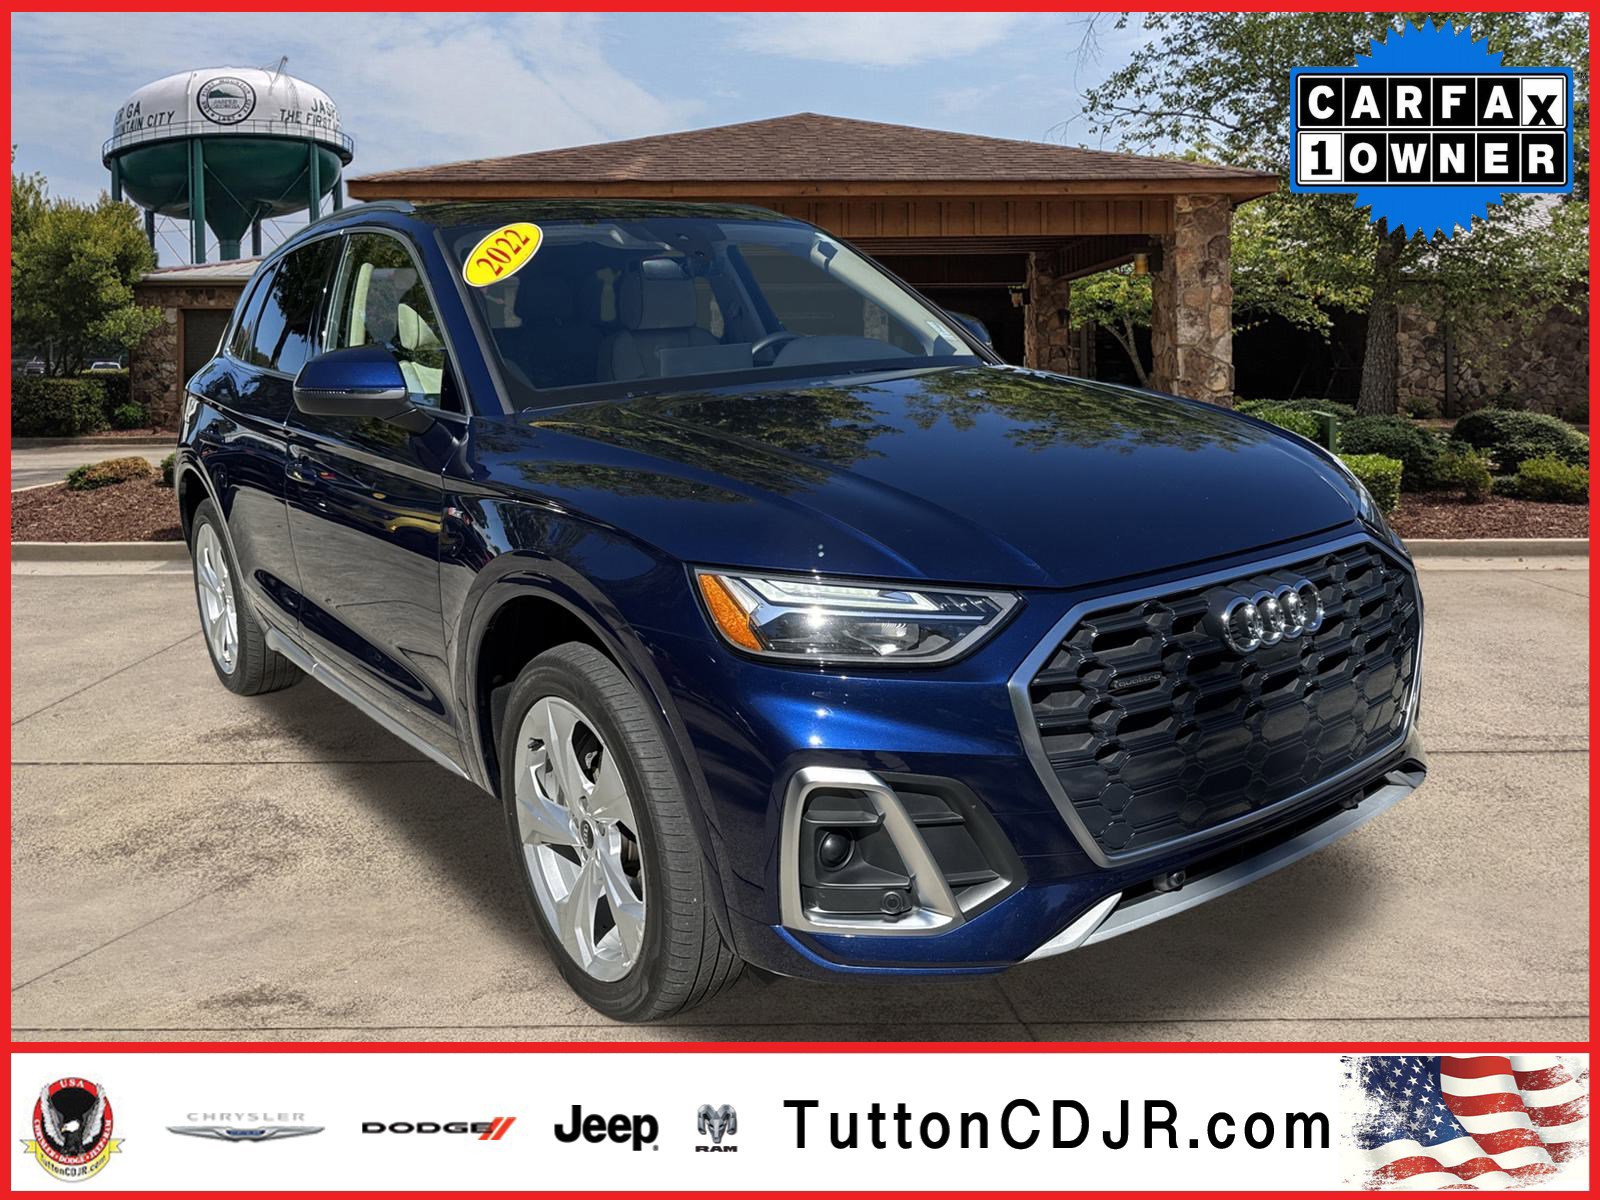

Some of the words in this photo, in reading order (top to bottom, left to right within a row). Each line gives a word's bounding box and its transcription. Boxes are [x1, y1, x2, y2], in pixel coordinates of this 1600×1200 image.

[147, 110, 175, 127] CITY
[280, 109, 302, 124] THE
[476, 230, 530, 276] 2022
